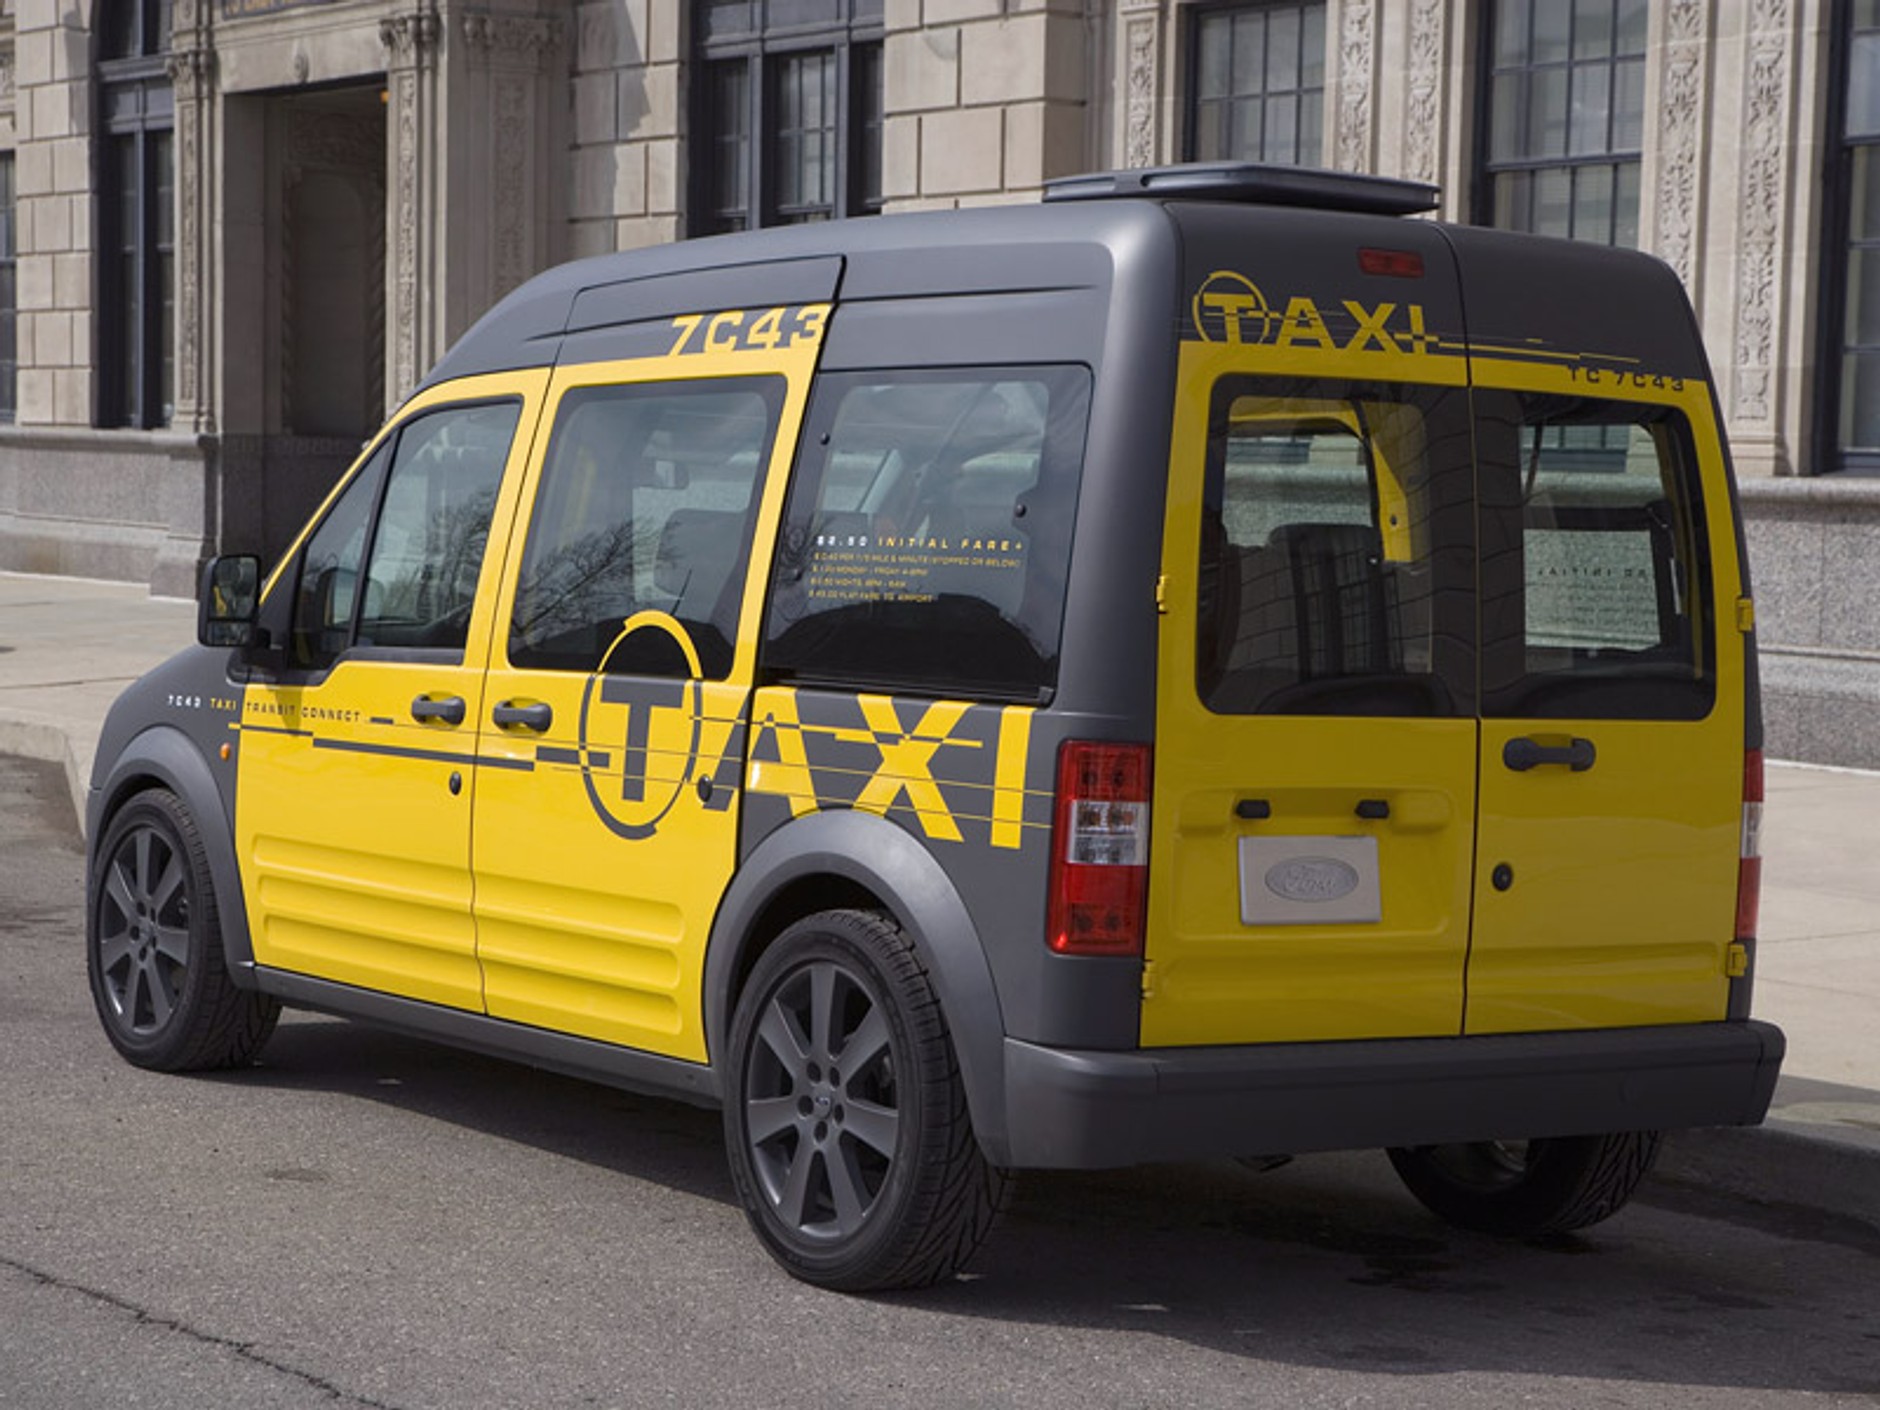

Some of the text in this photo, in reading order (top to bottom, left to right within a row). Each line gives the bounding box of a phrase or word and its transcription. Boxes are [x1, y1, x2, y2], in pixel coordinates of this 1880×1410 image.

[666, 302, 832, 357] 7C43
[1202, 291, 1429, 354] TAXI
[1568, 362, 1599, 384] TC
[878, 536, 949, 550] INITIAL
[210, 697, 238, 711] TAXI
[246, 701, 296, 716] TRANSIT
[301, 706, 361, 722] CONNECT
[598, 674, 1038, 850] TAXI
